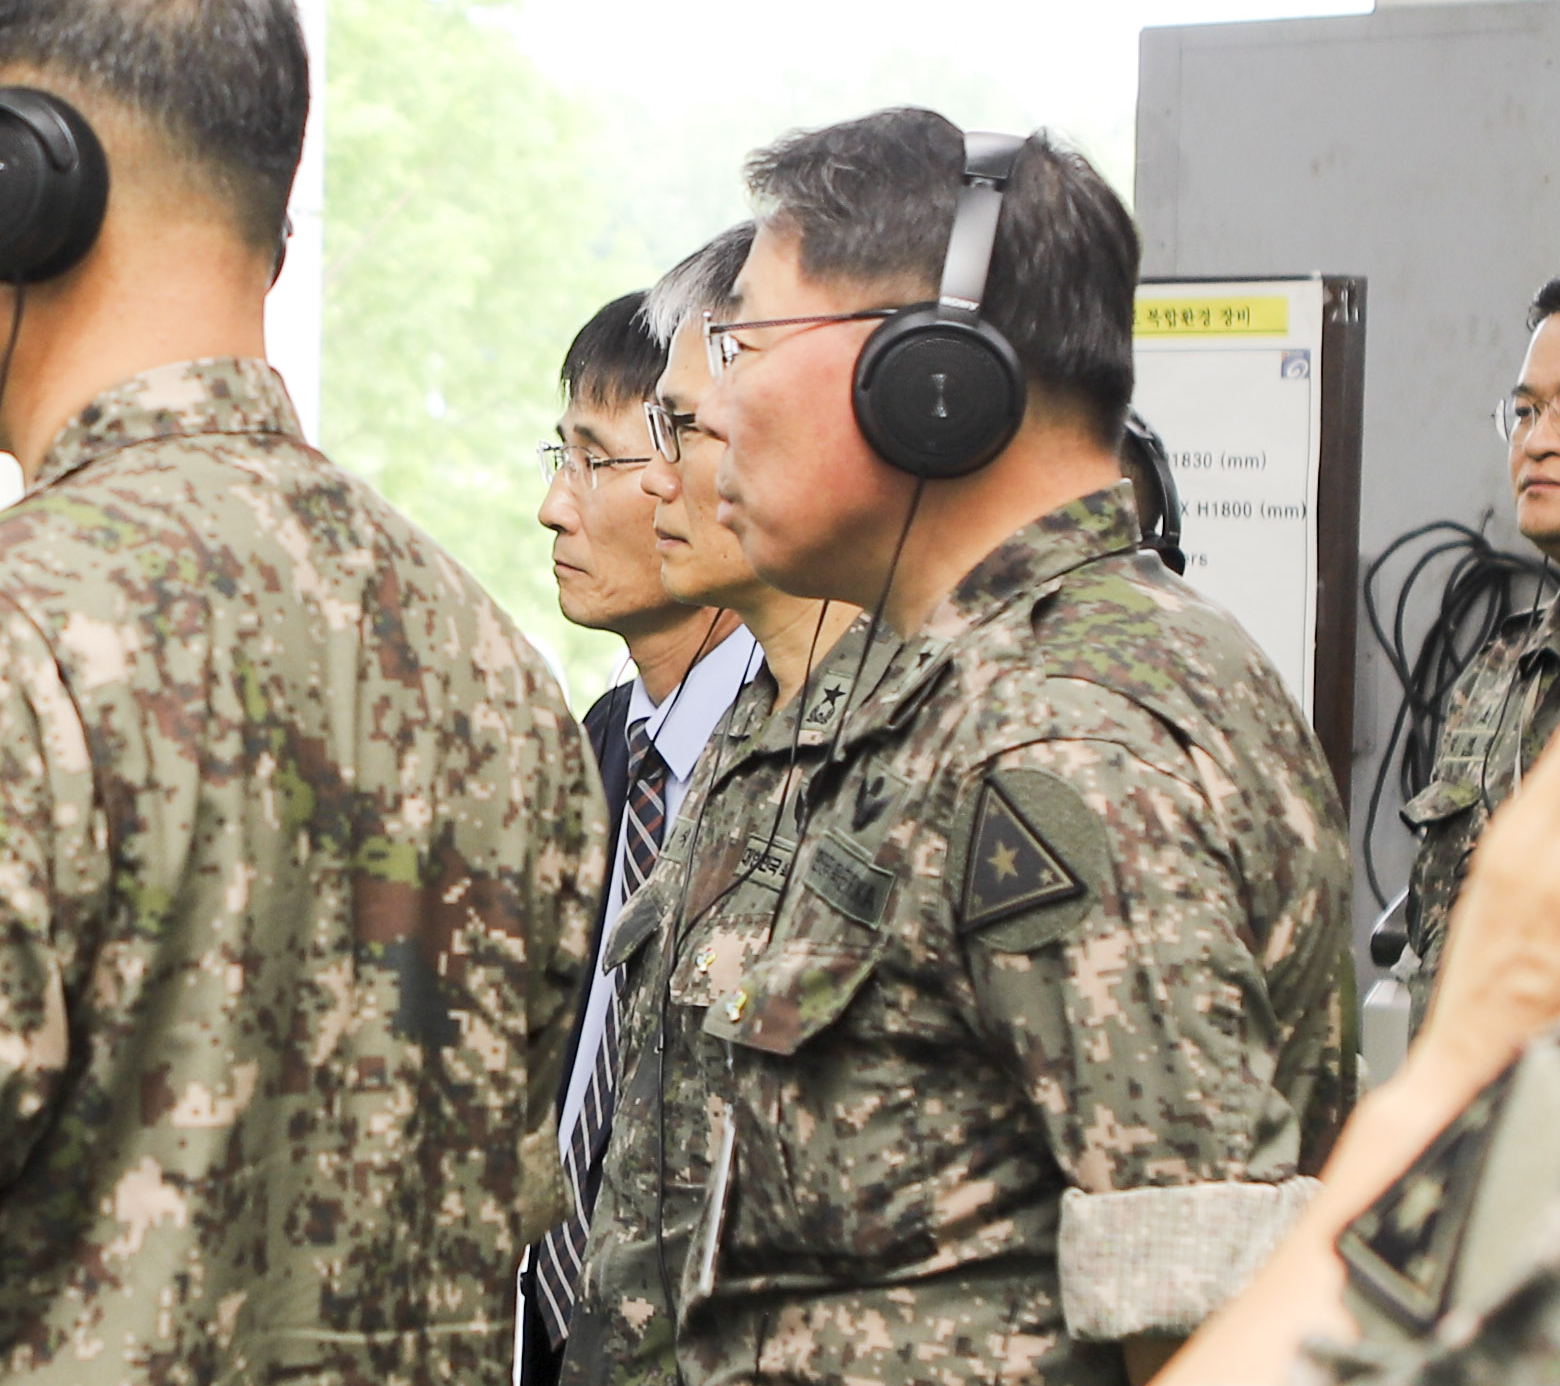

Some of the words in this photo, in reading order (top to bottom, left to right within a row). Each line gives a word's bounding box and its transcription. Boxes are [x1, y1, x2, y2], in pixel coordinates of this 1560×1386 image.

[1147, 308, 1211, 328] 복합환경
[1220, 307, 1252, 327] 장비
[1221, 451, 1267, 470] (mm)
[1197, 501, 1252, 518] H1800
[1260, 502, 1307, 520] (mm)
